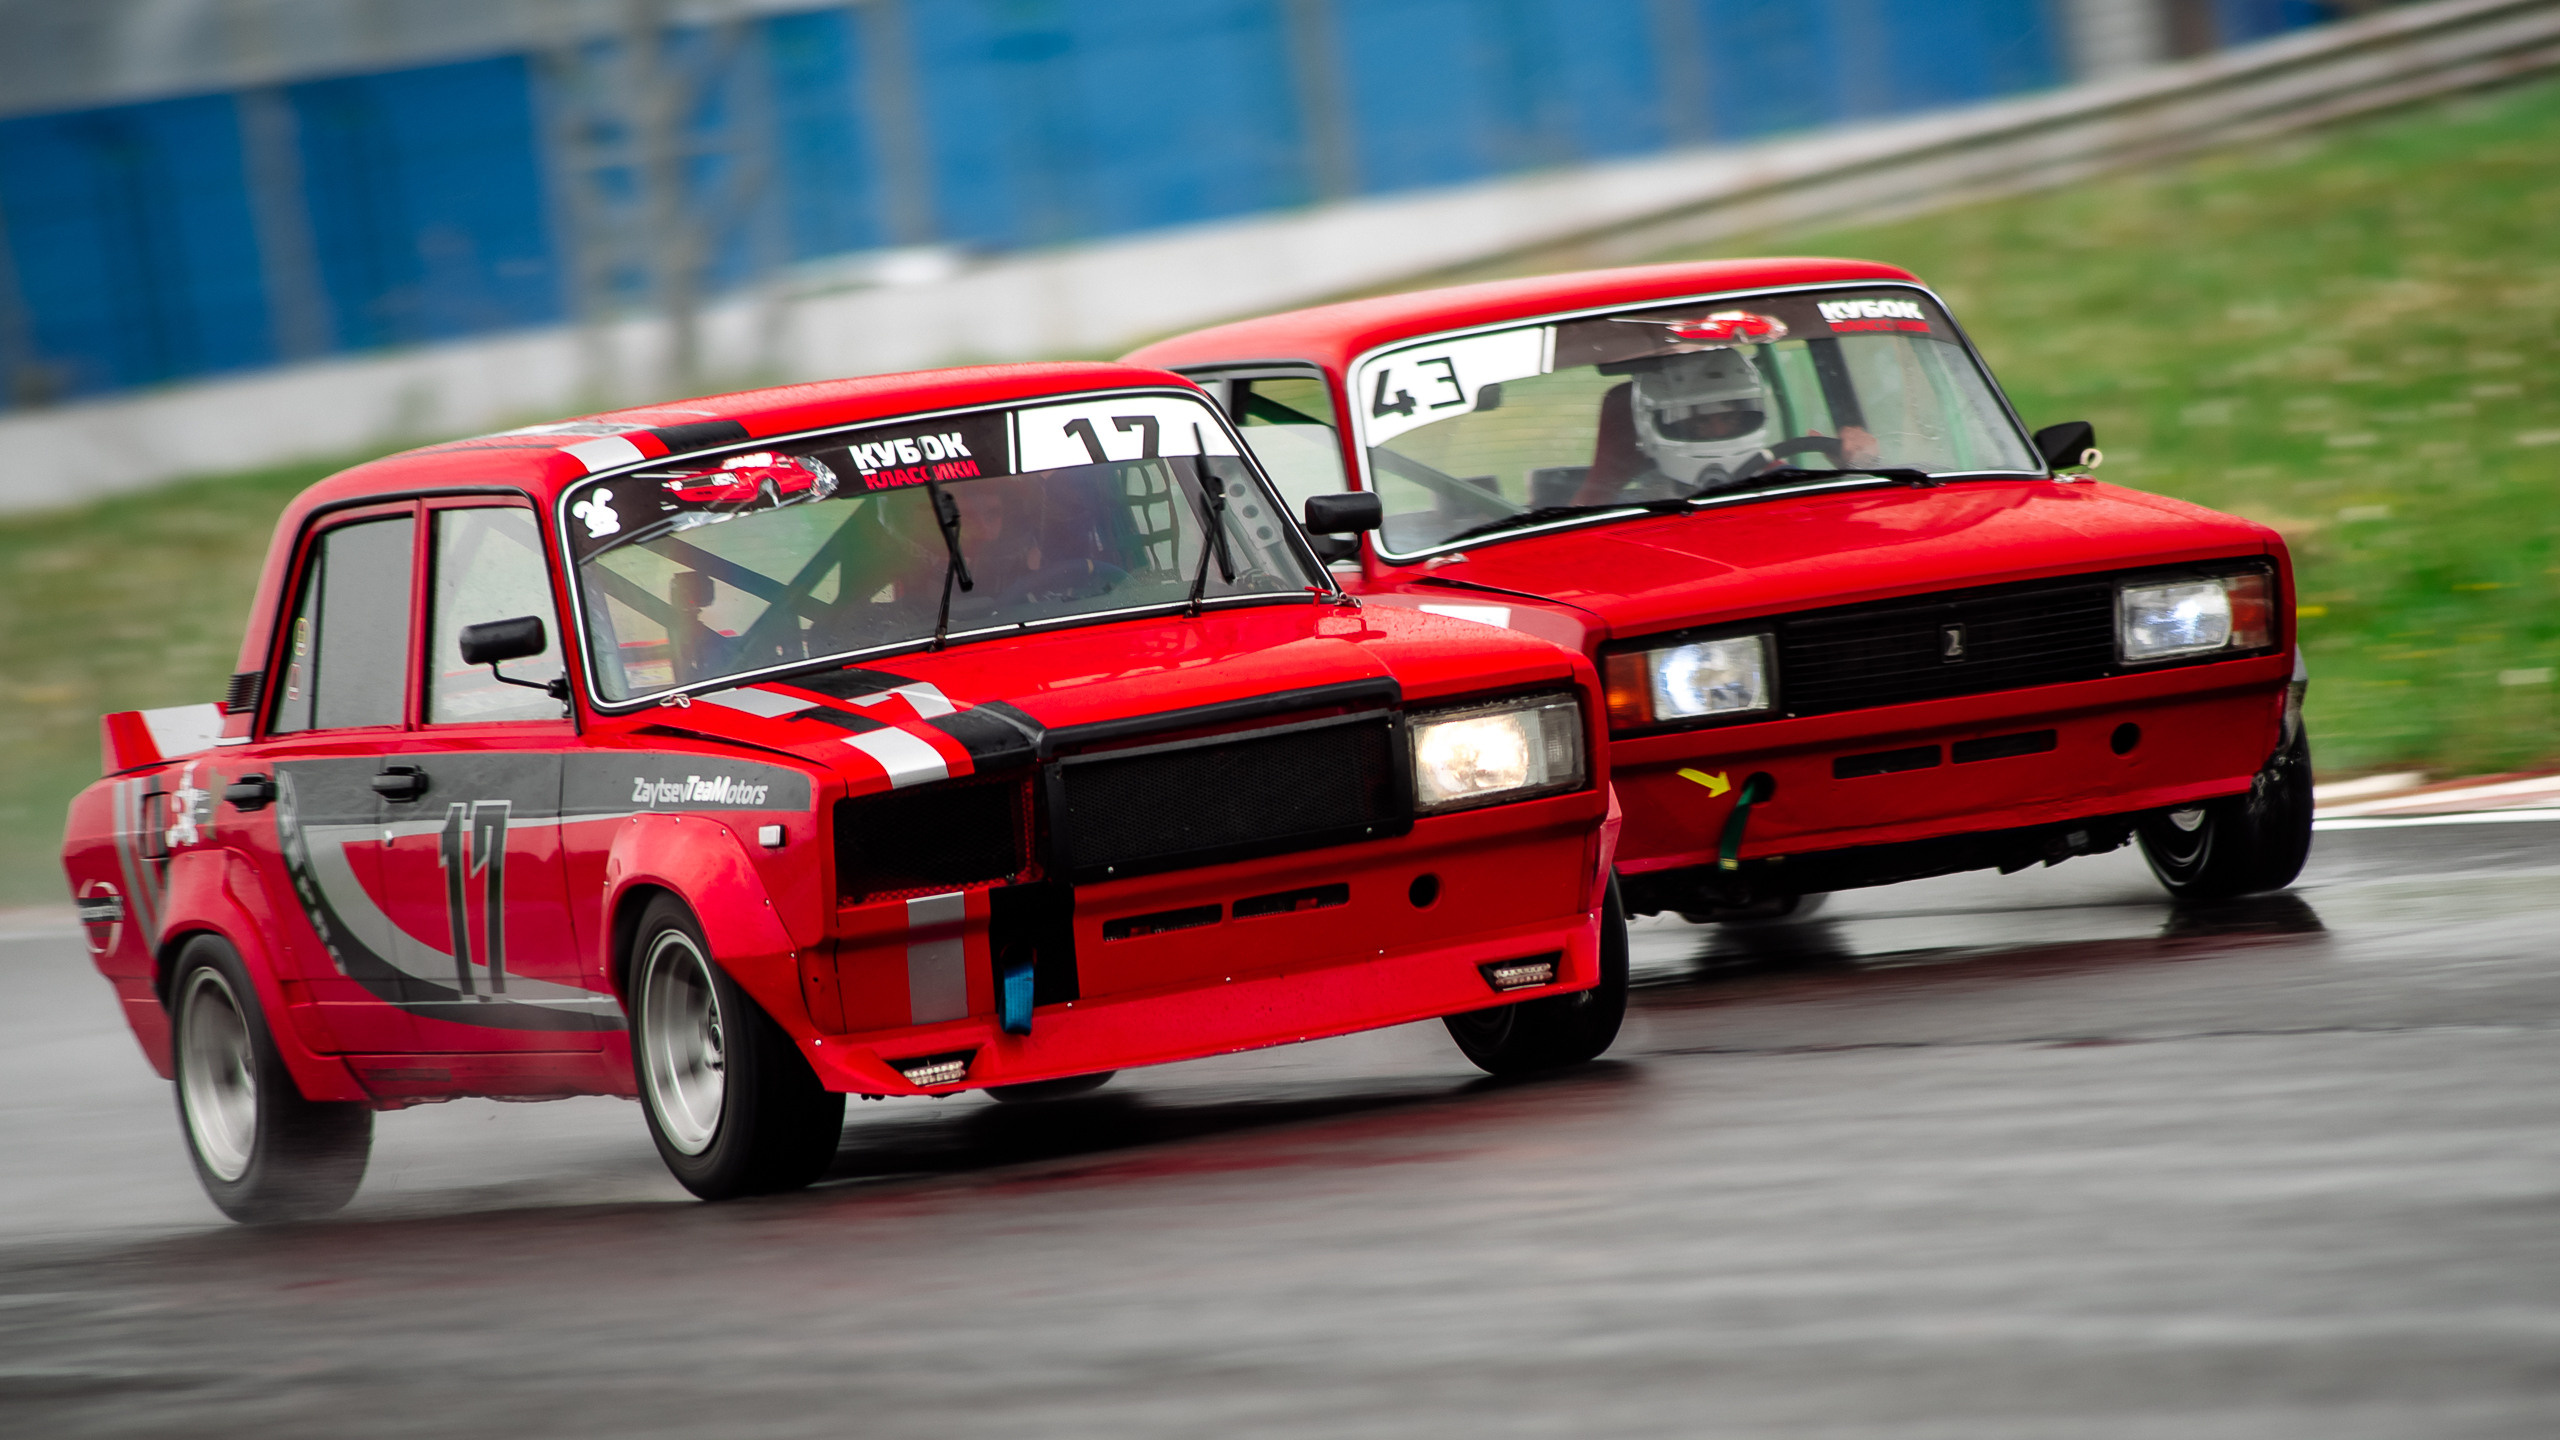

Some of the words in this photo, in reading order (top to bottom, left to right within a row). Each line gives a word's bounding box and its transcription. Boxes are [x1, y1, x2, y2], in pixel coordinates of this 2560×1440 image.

[1816, 300, 1925, 320] КУБОК
[1373, 356, 1466, 419] 43
[848, 432, 972, 470] КУБОК
[1063, 415, 1160, 464] 17
[863, 460, 981, 490] КЛАССИКИ
[438, 800, 512, 1002] 17
